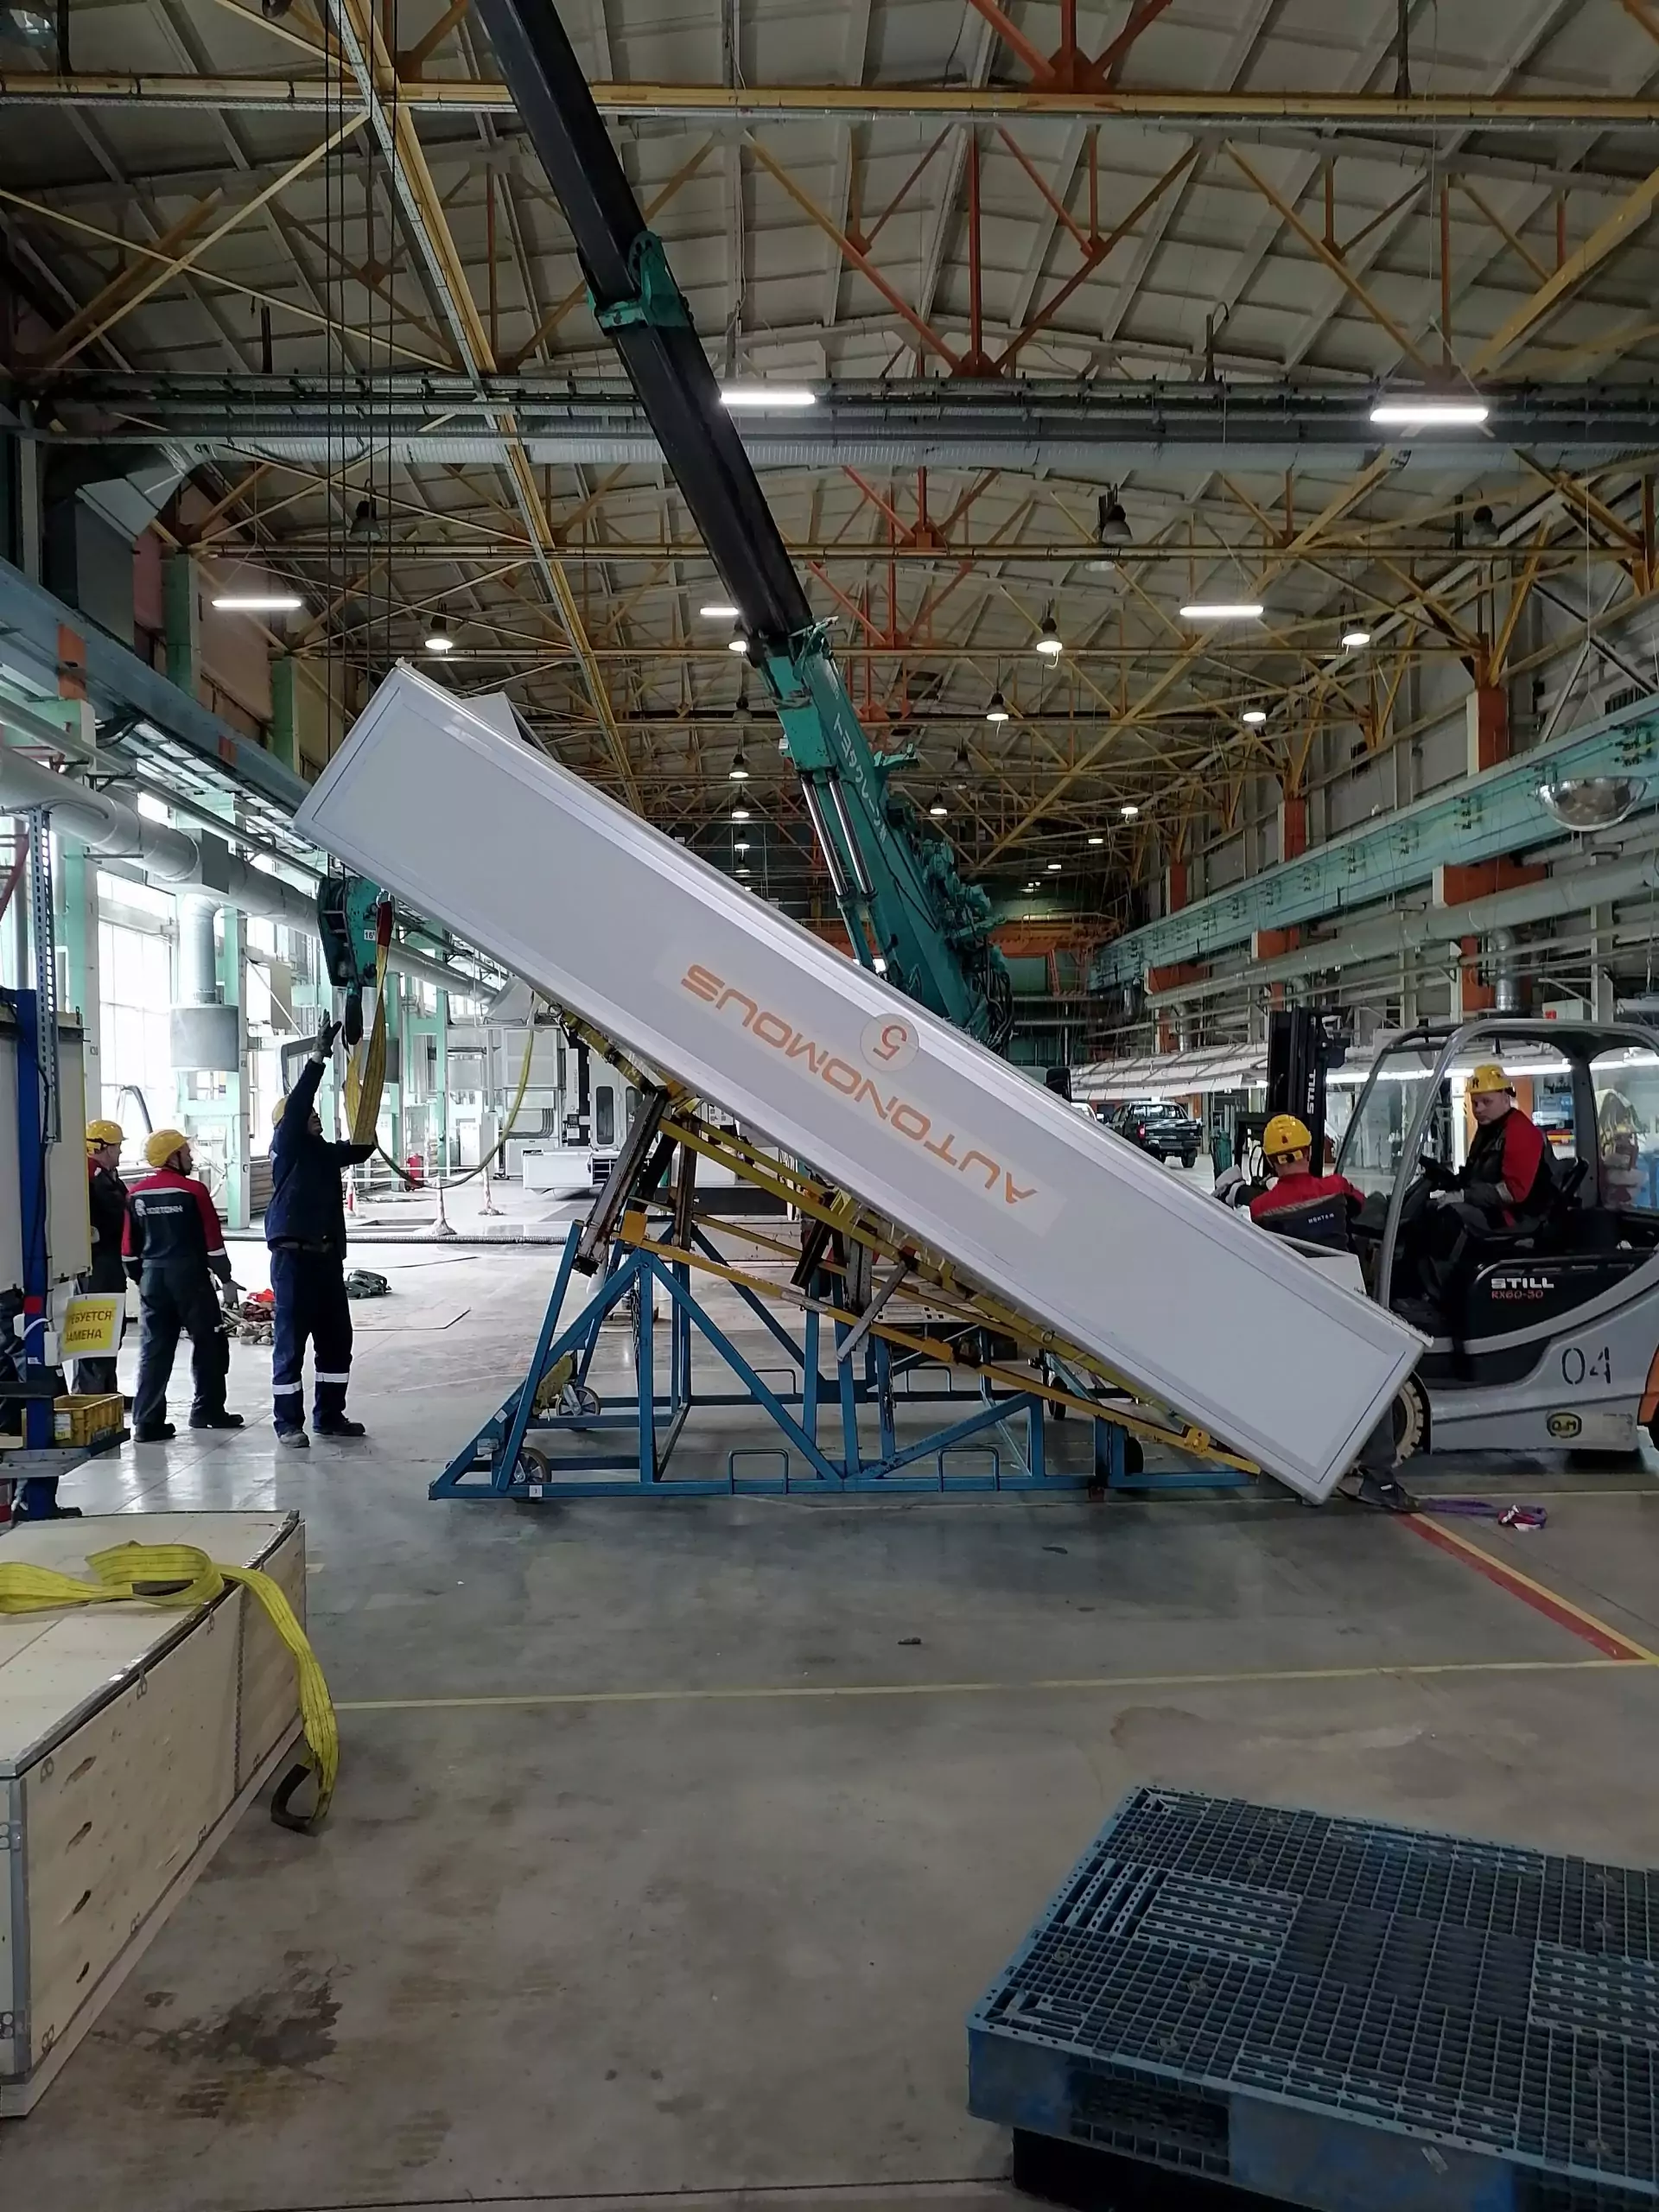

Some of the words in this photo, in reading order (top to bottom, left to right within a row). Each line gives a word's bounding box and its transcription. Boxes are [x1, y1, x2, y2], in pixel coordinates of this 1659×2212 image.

[873, 1024, 908, 1061] 5
[681, 963, 1039, 1205] AUTONOMOUS
[1306, 1068, 1316, 1115] STILL
[1491, 1277, 1554, 1289] STILL
[1561, 1346, 1611, 1385] 04
